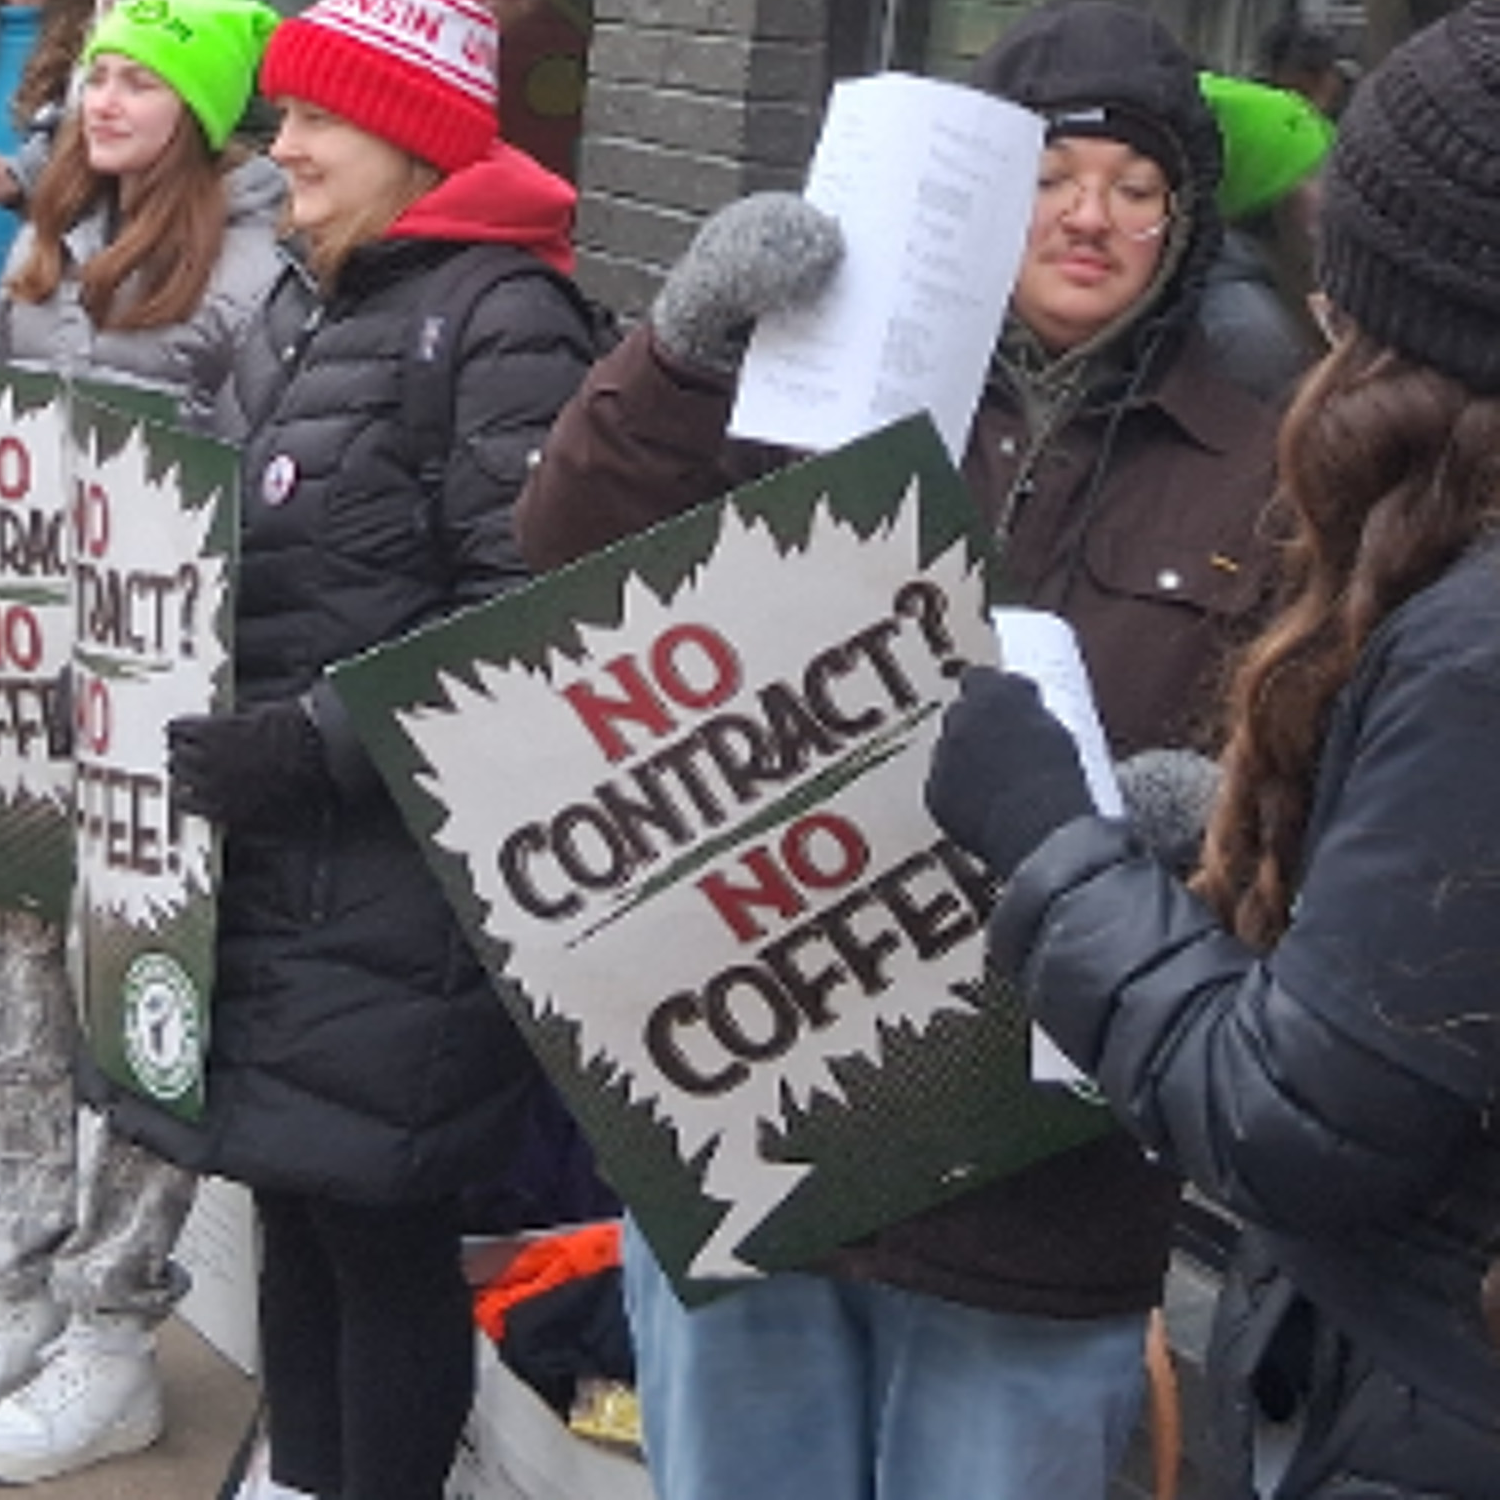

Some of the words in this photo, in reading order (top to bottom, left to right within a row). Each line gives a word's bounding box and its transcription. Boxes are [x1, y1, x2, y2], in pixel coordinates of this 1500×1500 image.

[498, 579, 969, 922] CONTRACT?
[561, 622, 743, 763] NO
[694, 812, 871, 943] NO
